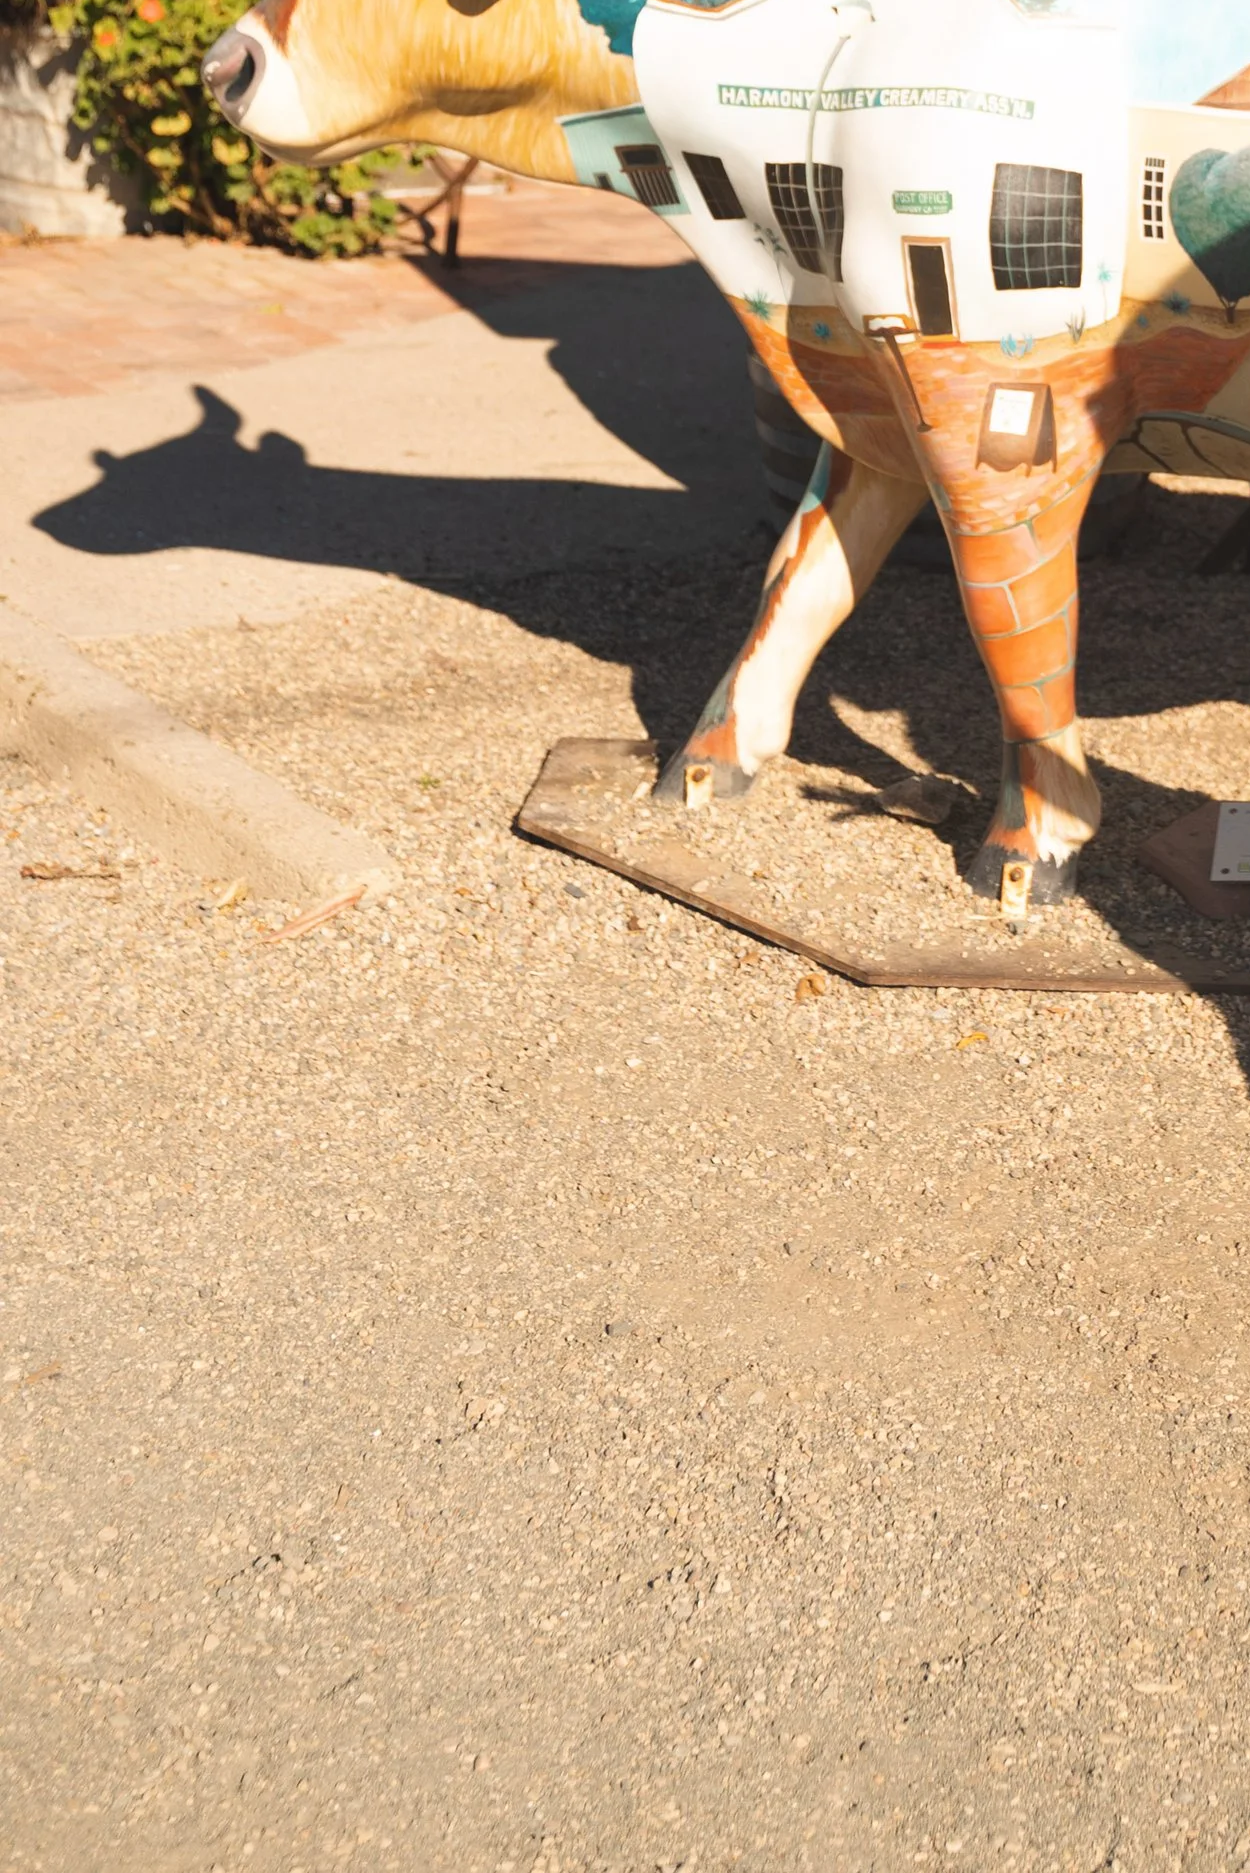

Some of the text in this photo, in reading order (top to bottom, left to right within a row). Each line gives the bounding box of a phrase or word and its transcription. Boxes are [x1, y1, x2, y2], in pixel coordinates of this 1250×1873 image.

[721, 86, 818, 109] HARMONY
[821, 88, 877, 110] VALLEY
[879, 88, 971, 107] CREAMERY
